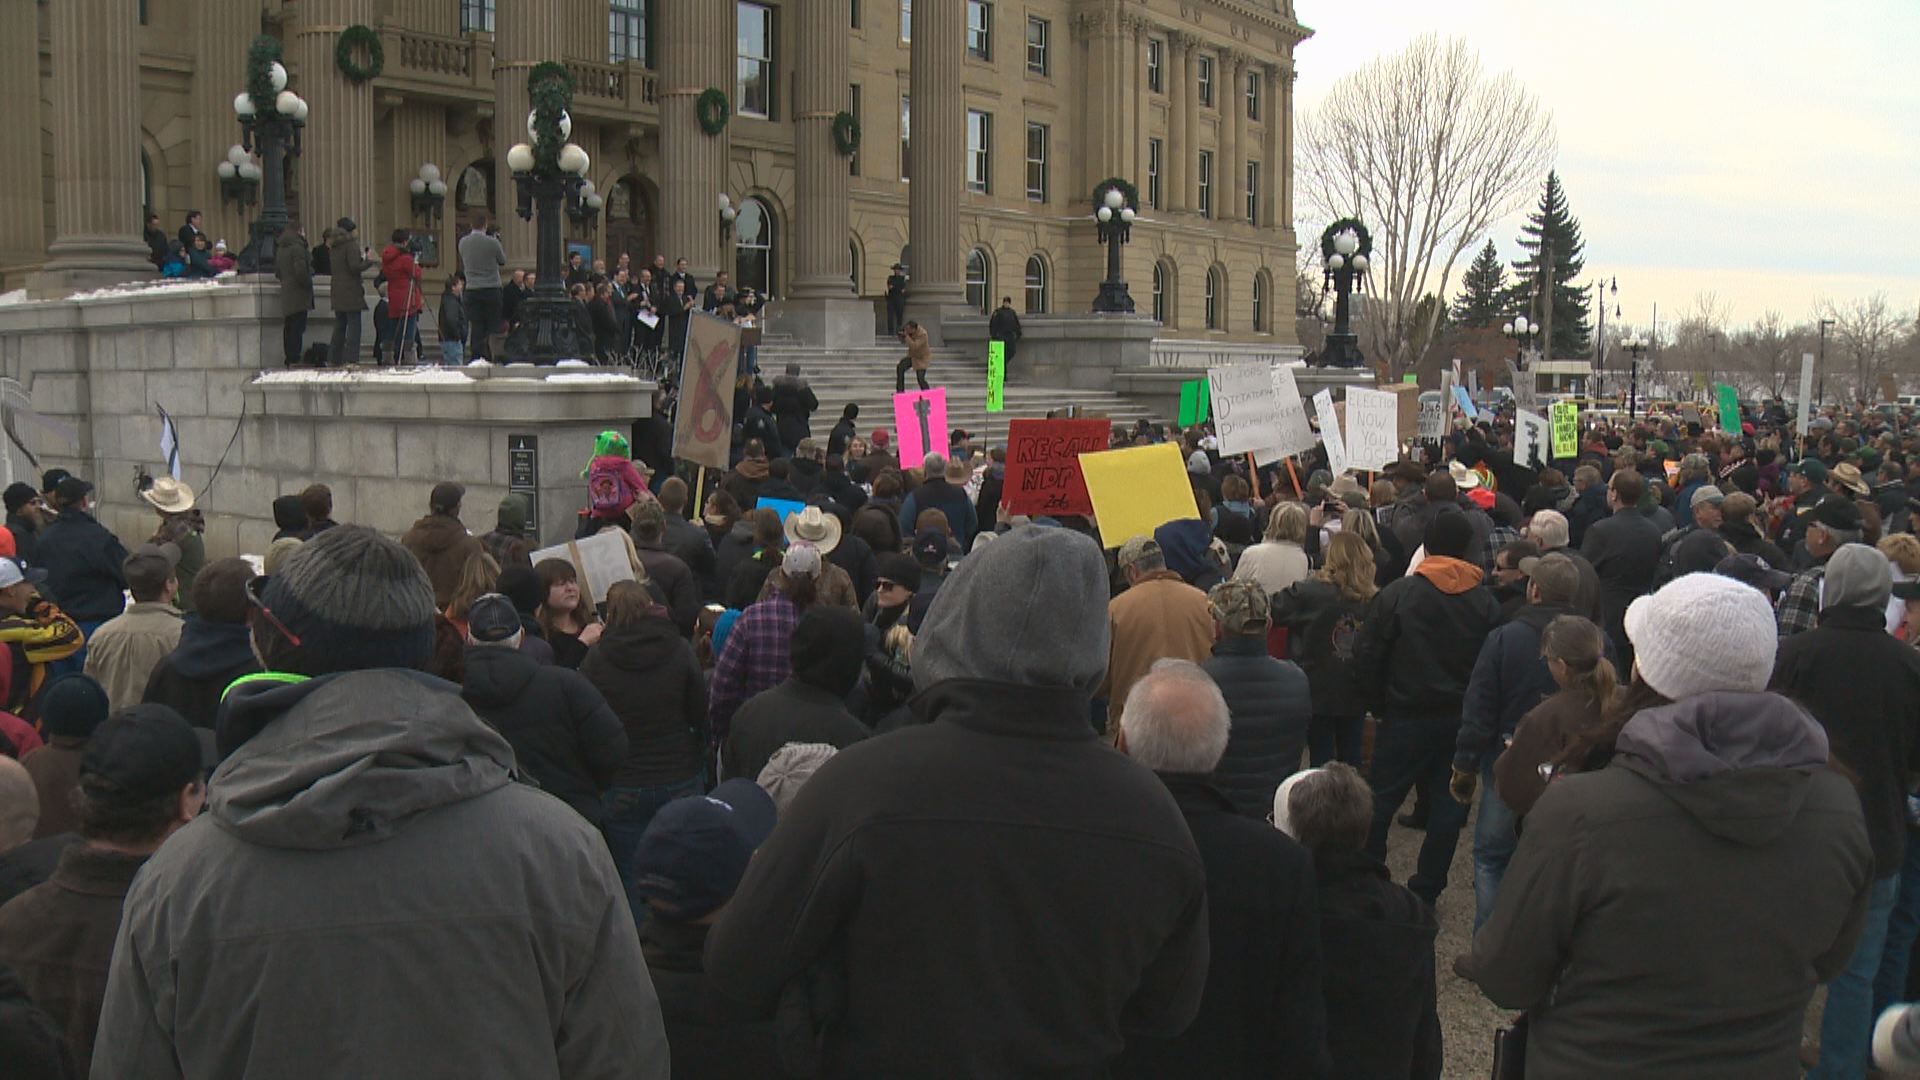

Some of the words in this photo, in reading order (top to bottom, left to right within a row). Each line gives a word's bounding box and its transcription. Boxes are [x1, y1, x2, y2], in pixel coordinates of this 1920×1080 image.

[1348, 393, 1396, 409] ELECTION
[1357, 411, 1387, 429] NOW
[1362, 430, 1387, 447] YOU
[1016, 437, 1100, 463] RECALL
[1351, 445, 1395, 467] LOSE
[1022, 466, 1075, 491] NDP
